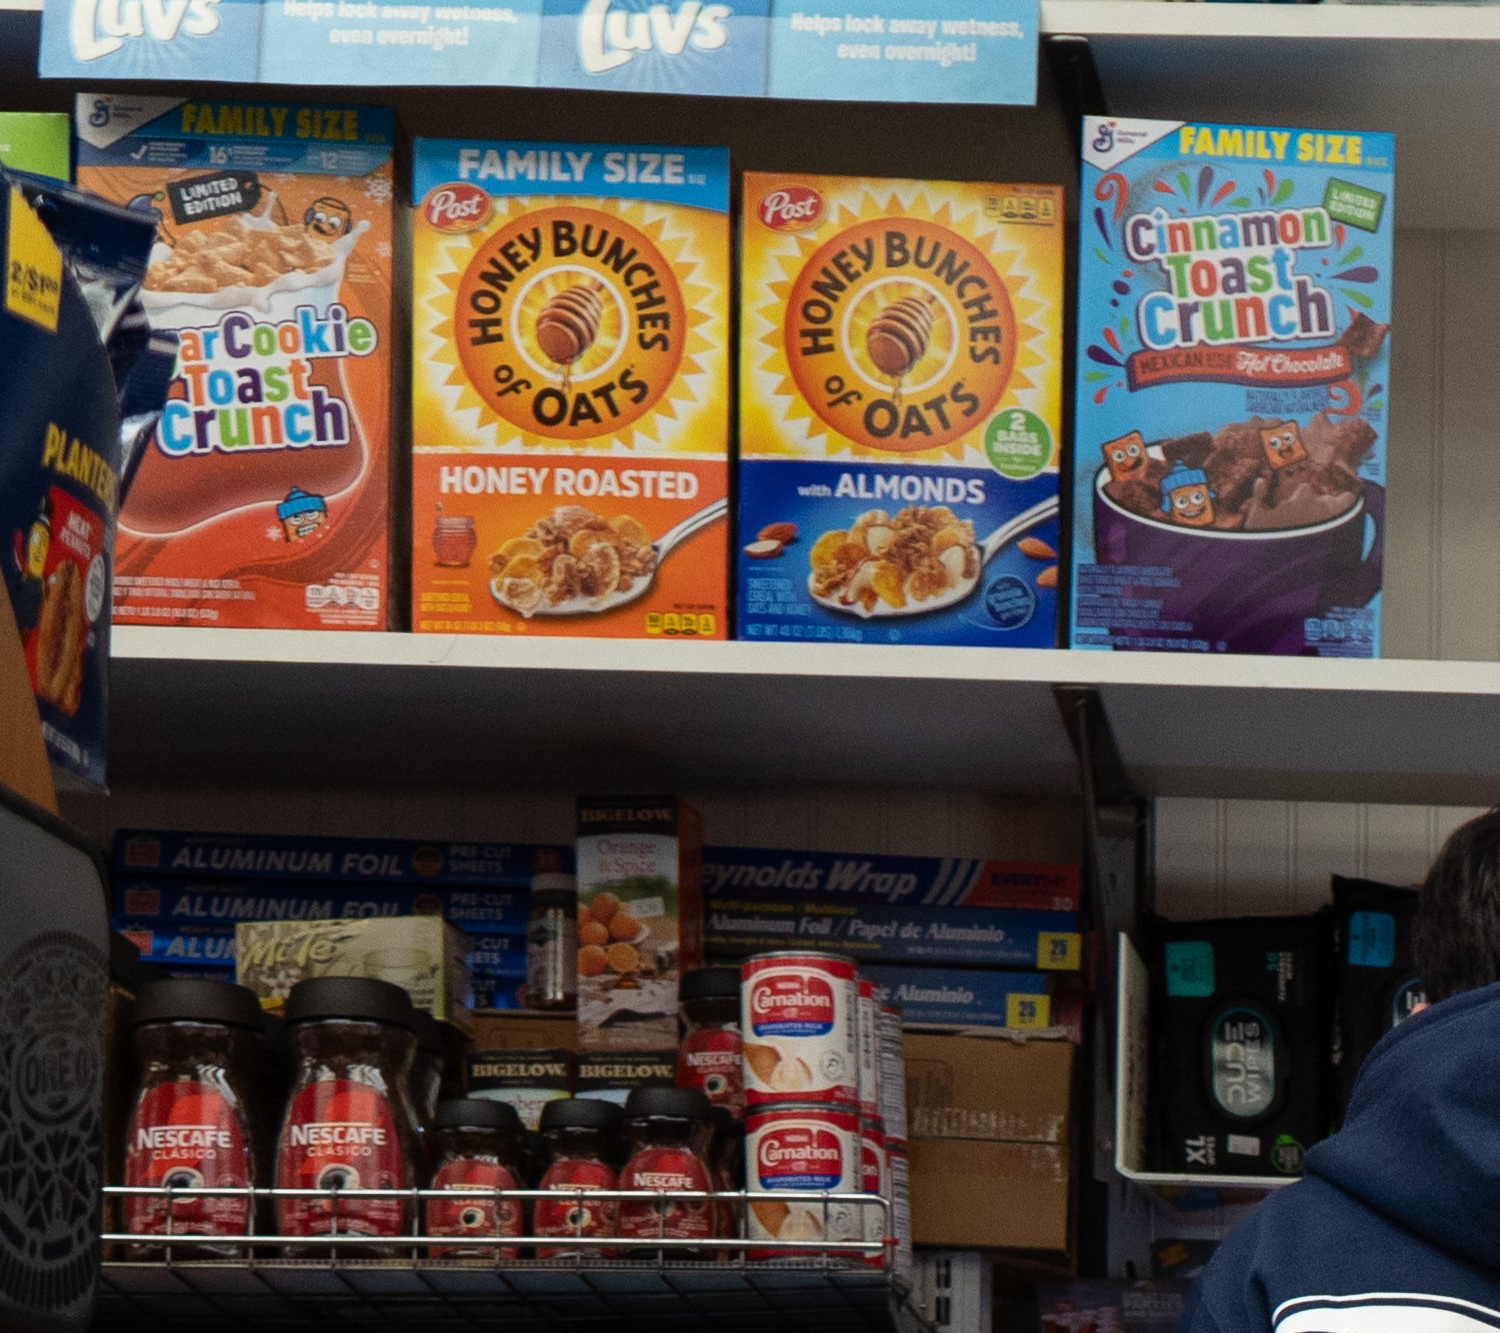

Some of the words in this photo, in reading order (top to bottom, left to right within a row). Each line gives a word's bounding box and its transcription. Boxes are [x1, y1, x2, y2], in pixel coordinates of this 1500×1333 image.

[330, 30, 373, 44] even
[377, 27, 469, 51] overnight!
[580, 0, 732, 73] Luvs
[791, 12, 841, 38] Helps
[846, 13, 883, 34] lock
[888, 18, 936, 40] away
[941, 19, 1023, 40] wetness,
[838, 44, 880, 59] even
[885, 41, 977, 67] overnight!
[181, 104, 289, 137] FAMILY
[296, 109, 358, 141] SIZE
[1179, 126, 1290, 160] FAMILY
[1297, 134, 1362, 165] SIZE
[458, 149, 592, 182] FAMILY
[603, 153, 686, 185] SIZE
[180, 177, 239, 201] LIMITED
[184, 191, 243, 215] EDITION
[430, 190, 481, 224] Post
[764, 191, 818, 224] Post
[1131, 211, 1327, 257] Cinnamon
[469, 227, 544, 347] HONEY
[552, 219, 671, 353] BUNCHES
[1168, 250, 1293, 299] Toast
[799, 237, 874, 356] HONEY
[885, 231, 1002, 365] BUNCHES
[1145, 279, 1329, 346] Crunch
[183, 360, 311, 406] Toast
[532, 365, 649, 427] OATS
[161, 390, 346, 452] Crunch
[863, 381, 981, 440] OATS
[1011, 412, 1026, 430] 2
[41, 421, 119, 513] PLANTE
[439, 466, 548, 494] HONEY
[554, 469, 698, 500] ROASTED
[798, 484, 832, 497] with
[835, 474, 986, 504] ALMONDS
[172, 848, 332, 874] ALUMINUM
[341, 853, 404, 876] FOIL
[826, 860, 919, 901] Wrap
[171, 895, 332, 921] ALUMINUM
[752, 986, 831, 1014] Carnation
[472, 1062, 568, 1079] BIGELOW
[580, 1064, 674, 1079] BIGELOW
[1224, 1021, 1247, 1104] DUDE
[1247, 1022, 1261, 1102] WIPES
[760, 1139, 838, 1168] Carnation
[1185, 1136, 1207, 1164] XL
